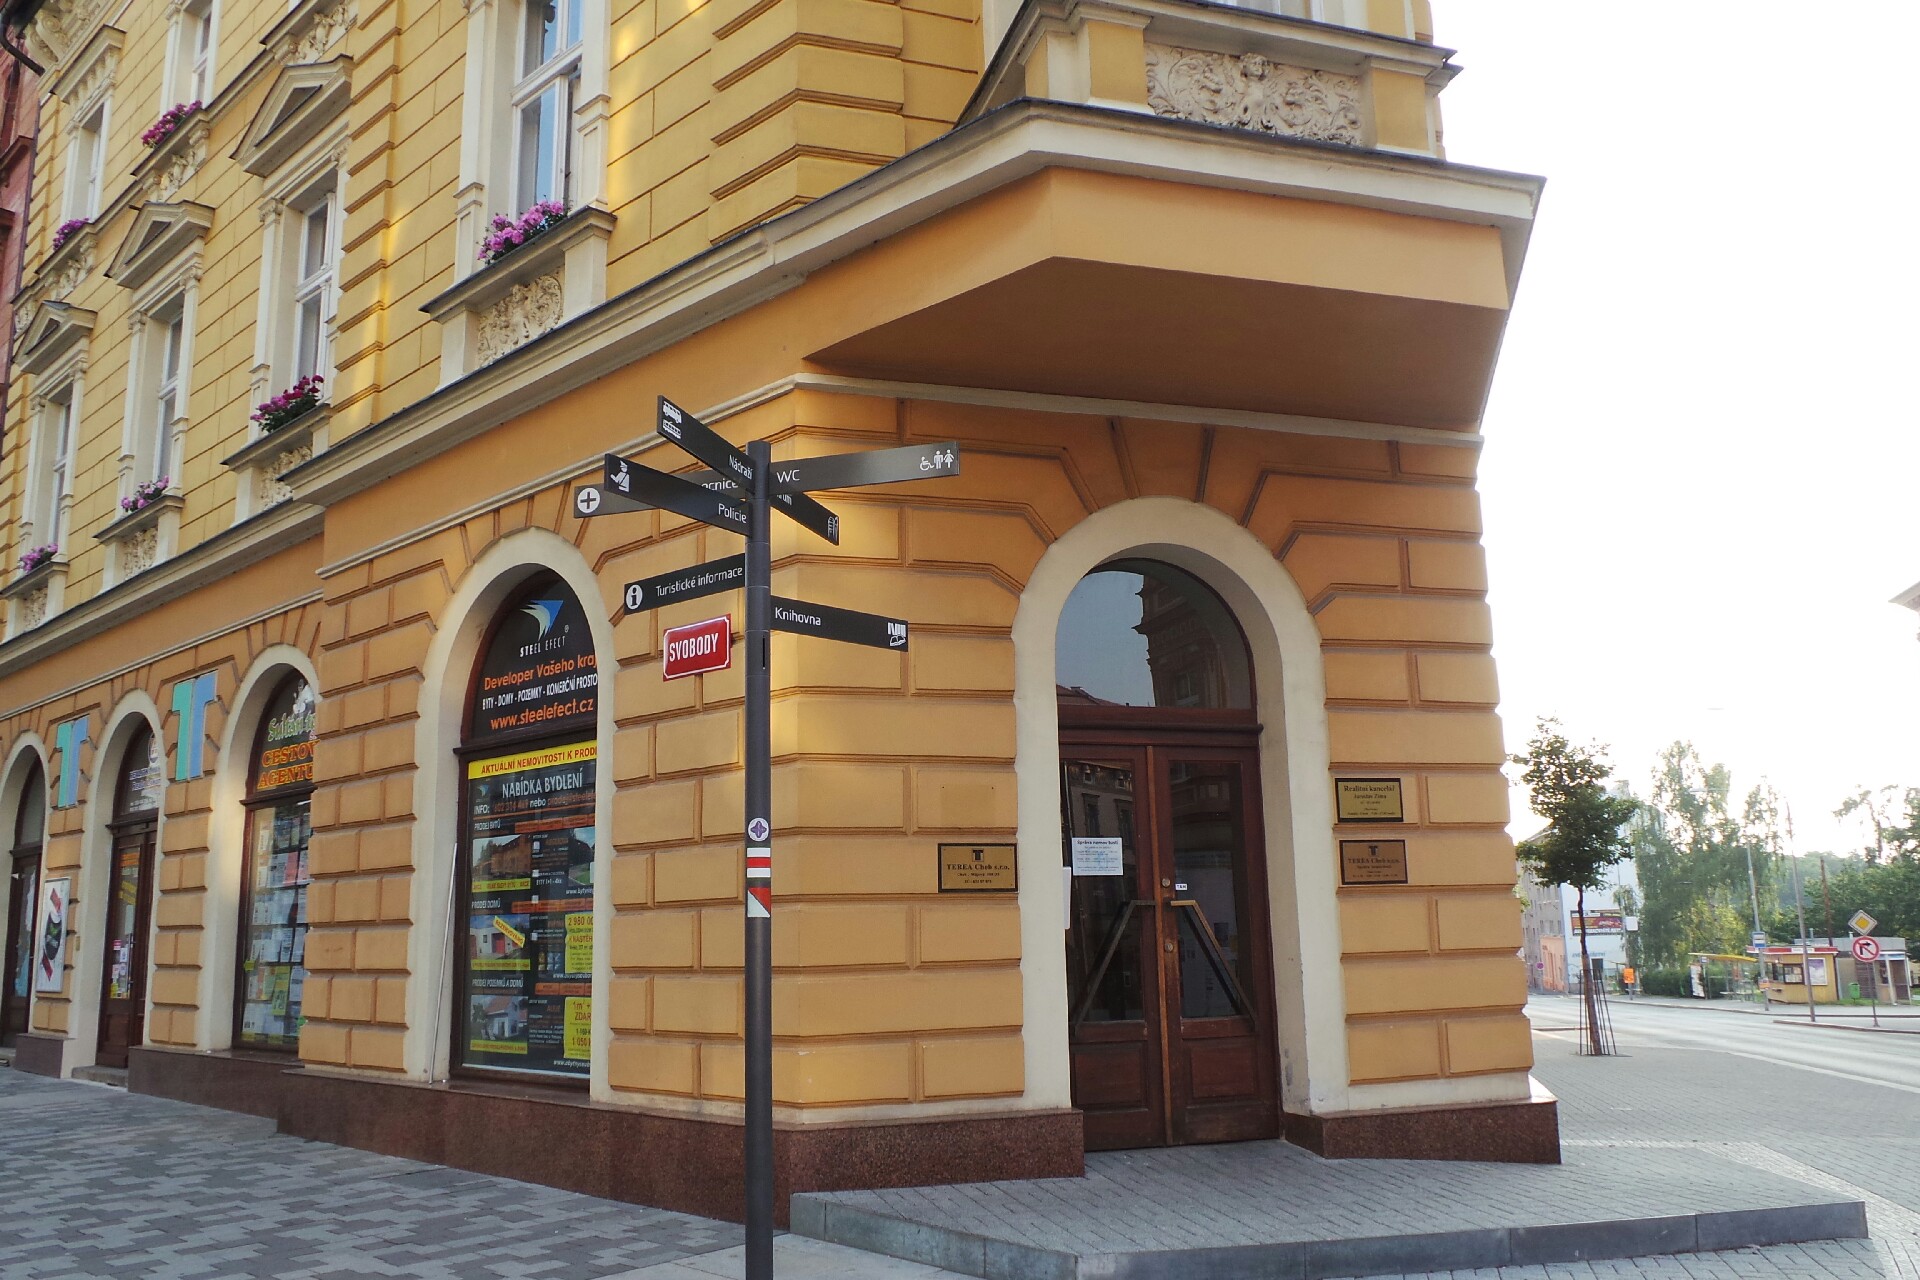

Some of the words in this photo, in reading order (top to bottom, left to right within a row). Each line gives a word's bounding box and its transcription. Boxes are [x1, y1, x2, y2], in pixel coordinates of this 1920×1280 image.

[729, 454, 754, 480] Nádraží
[777, 469, 800, 484] WC
[718, 503, 747, 524] Policie
[655, 574, 696, 597] Turistické
[698, 566, 743, 590] informace
[775, 607, 822, 627] Knihovna
[520, 642, 541, 657] STEEL
[545, 635, 566, 651] EFECT
[669, 633, 719, 662] SVOBODY
[484, 669, 534, 691] Developer
[537, 659, 575, 676] Vašeho
[498, 693, 514, 708] DOMY
[518, 686, 543, 702] POZEMKY
[546, 674, 576, 696] KOMERČNÍ
[491, 698, 594, 729] www.steelefect.cz
[517, 752, 565, 769] NEMOVITOSTI
[567, 750, 573, 760] K
[574, 746, 598, 759] PROD
[502, 776, 543, 799] NABÍDKA
[544, 767, 583, 793] BYDLENÍ
[530, 797, 546, 808] nebo
